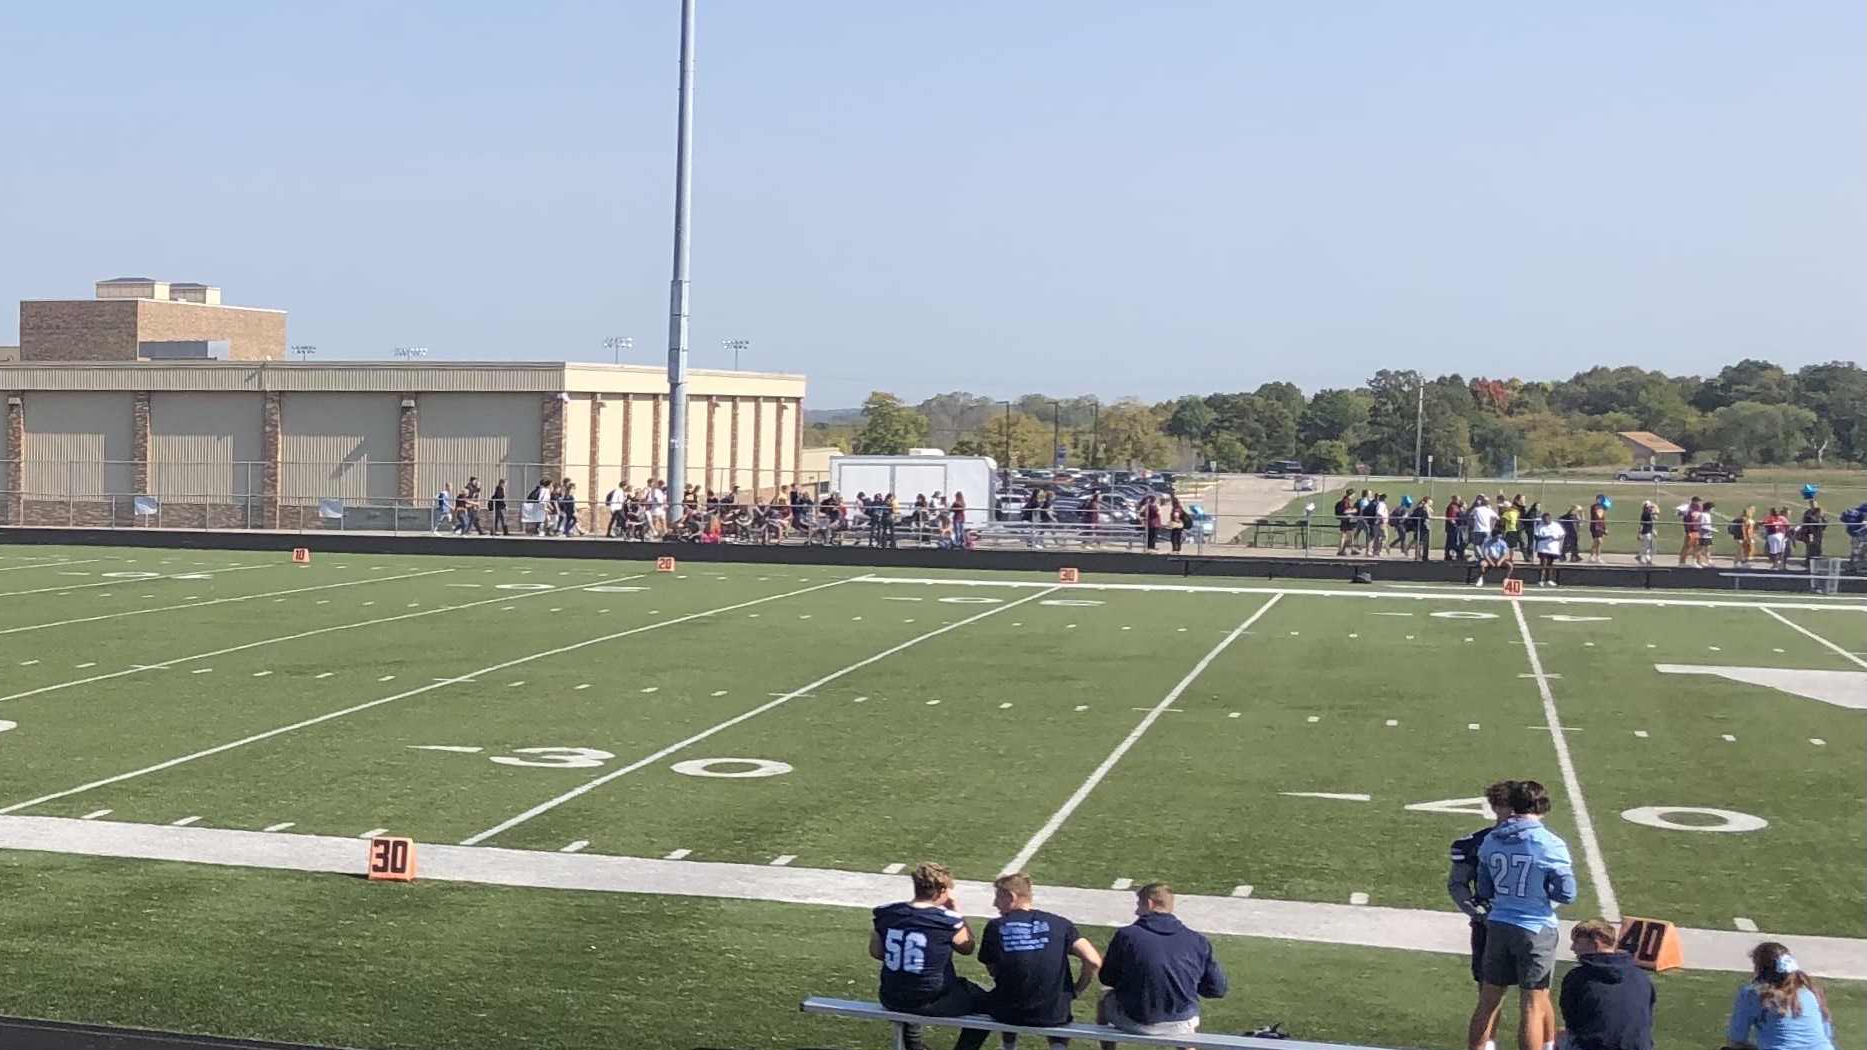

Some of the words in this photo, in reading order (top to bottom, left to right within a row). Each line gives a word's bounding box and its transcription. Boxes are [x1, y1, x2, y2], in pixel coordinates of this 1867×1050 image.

[295, 549, 306, 560] 10
[659, 558, 673, 569] 20
[1060, 569, 1076, 581] 30
[1504, 580, 1521, 594] 40
[372, 838, 409, 874] 30
[1488, 851, 1534, 897] 27
[884, 927, 928, 974] 56
[1616, 919, 1667, 963] 40
